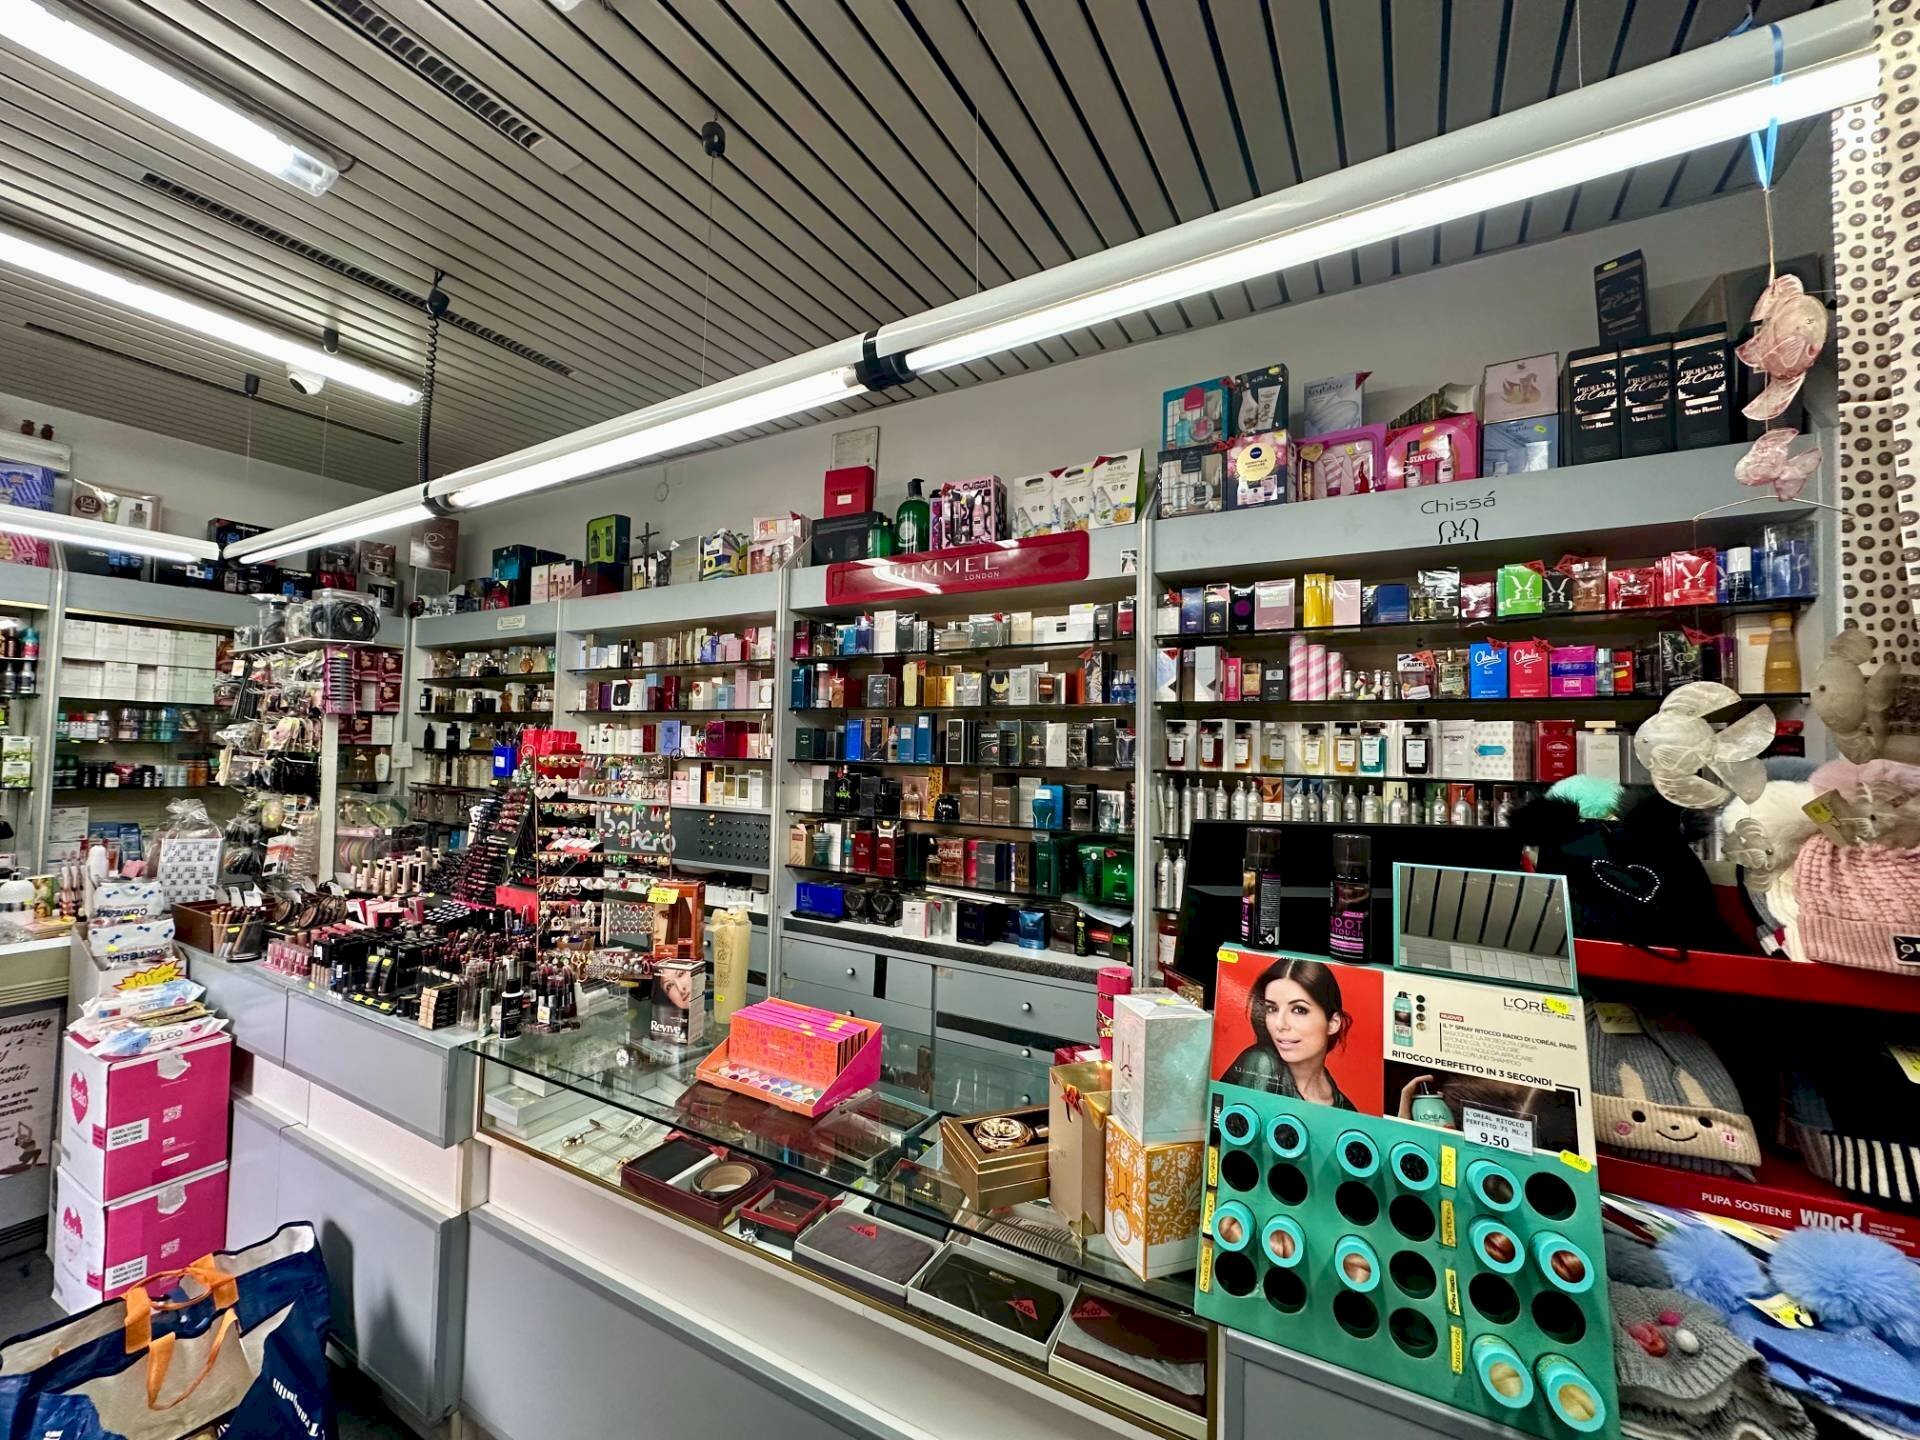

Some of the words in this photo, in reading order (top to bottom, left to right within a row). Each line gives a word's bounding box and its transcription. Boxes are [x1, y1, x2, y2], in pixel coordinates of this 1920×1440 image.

[1692, 370, 1726, 384] Casa
[1587, 388, 1617, 400] Casa
[1421, 491, 1496, 515] Chissá
[894, 556, 1000, 579] RIMMEL
[965, 572, 1000, 581] LONDON
[0, 1018, 53, 1036] ancing
[651, 1020, 681, 1035] Revive
[1475, 1028, 1501, 1037] RITOCCO
[1392, 1050, 1433, 1065] RITOCCO
[1434, 1058, 1484, 1074] PERFETTO
[1486, 1067, 1496, 1076] IN
[1498, 1069, 1505, 1077] 3
[1507, 1071, 1552, 1087] SECONDI
[1466, 1119, 1497, 1132] PERFETTO
[1496, 1117, 1525, 1129] RITOCCO
[1701, 1192, 1732, 1207] PUPA
[1735, 1199, 1792, 1219] SOSTIENE
